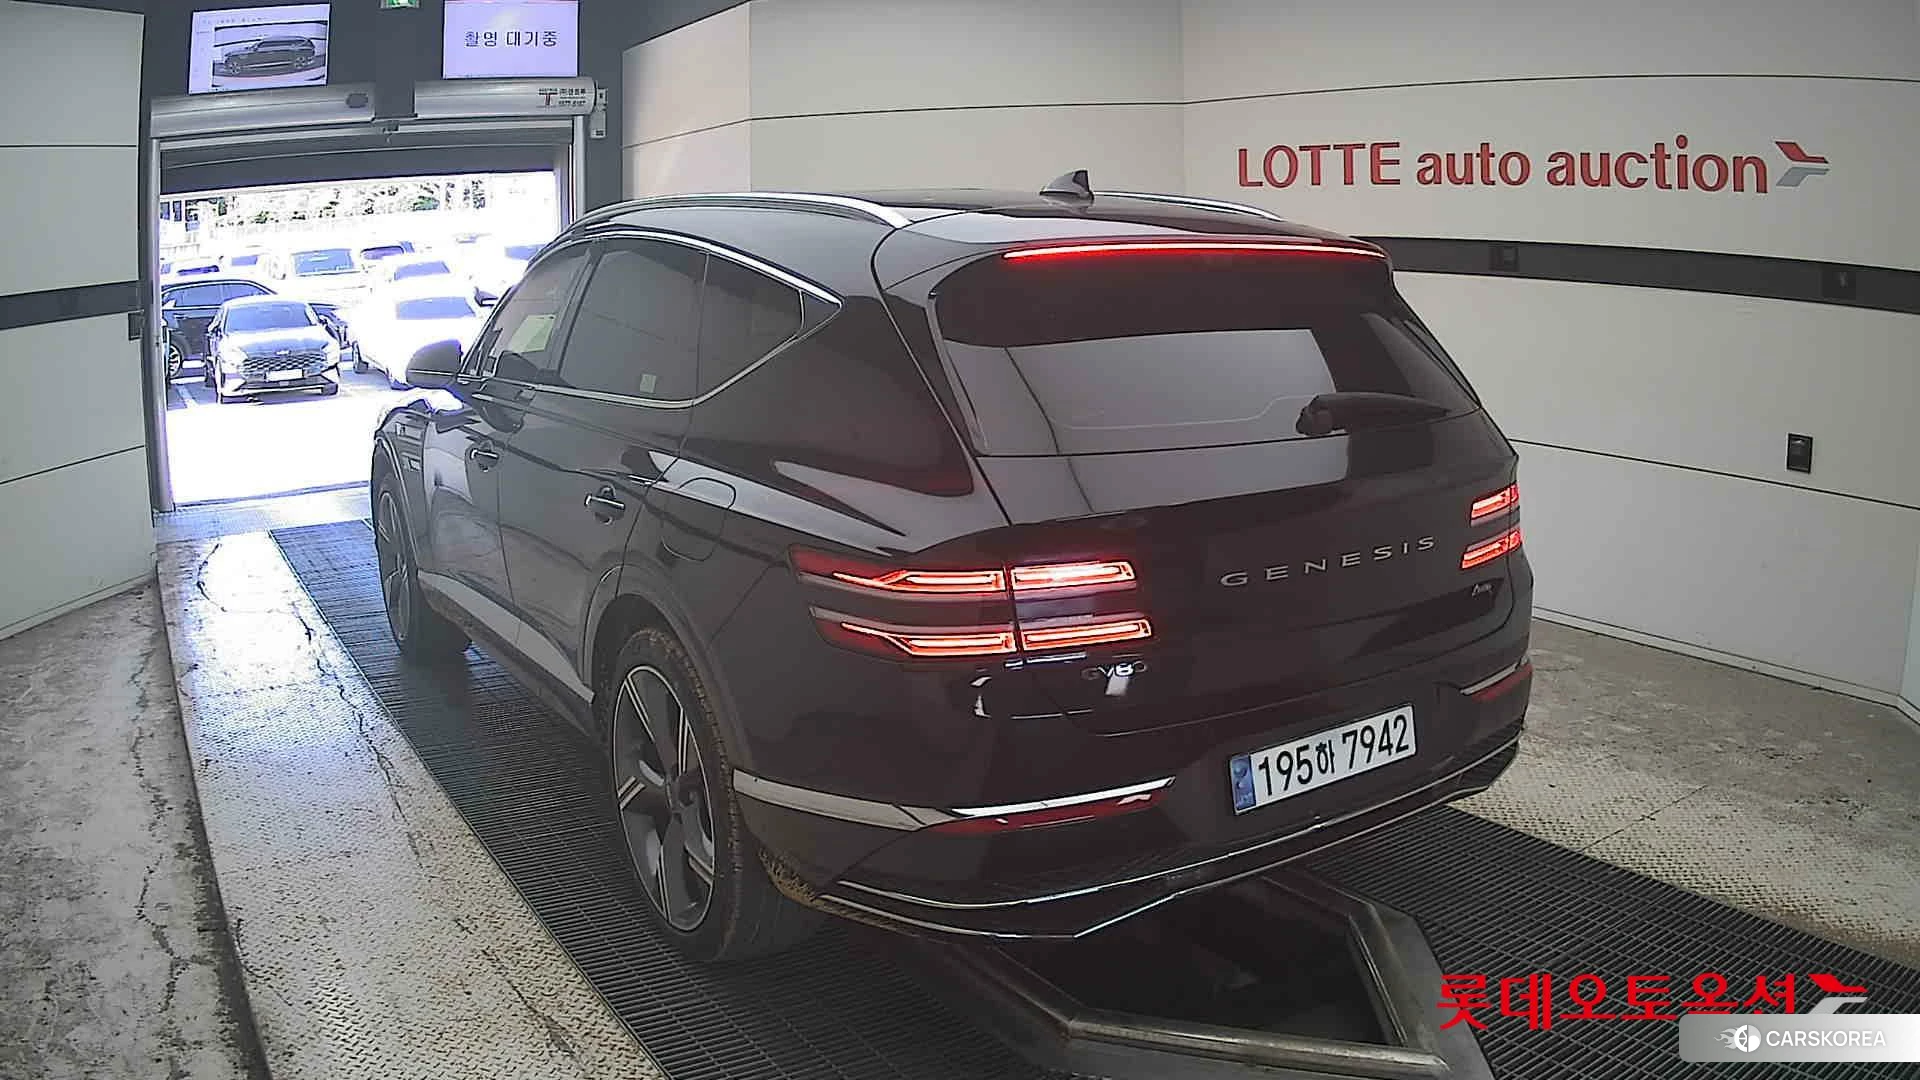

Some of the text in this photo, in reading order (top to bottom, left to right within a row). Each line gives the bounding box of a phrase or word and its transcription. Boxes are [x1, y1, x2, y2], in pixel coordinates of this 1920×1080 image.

[506, 31, 558, 47] 대기중
[1237, 134, 1768, 194] LOTTE auto auction
[1219, 536, 1435, 587] GENESIS
[1258, 714, 1410, 796] 195하 7942
